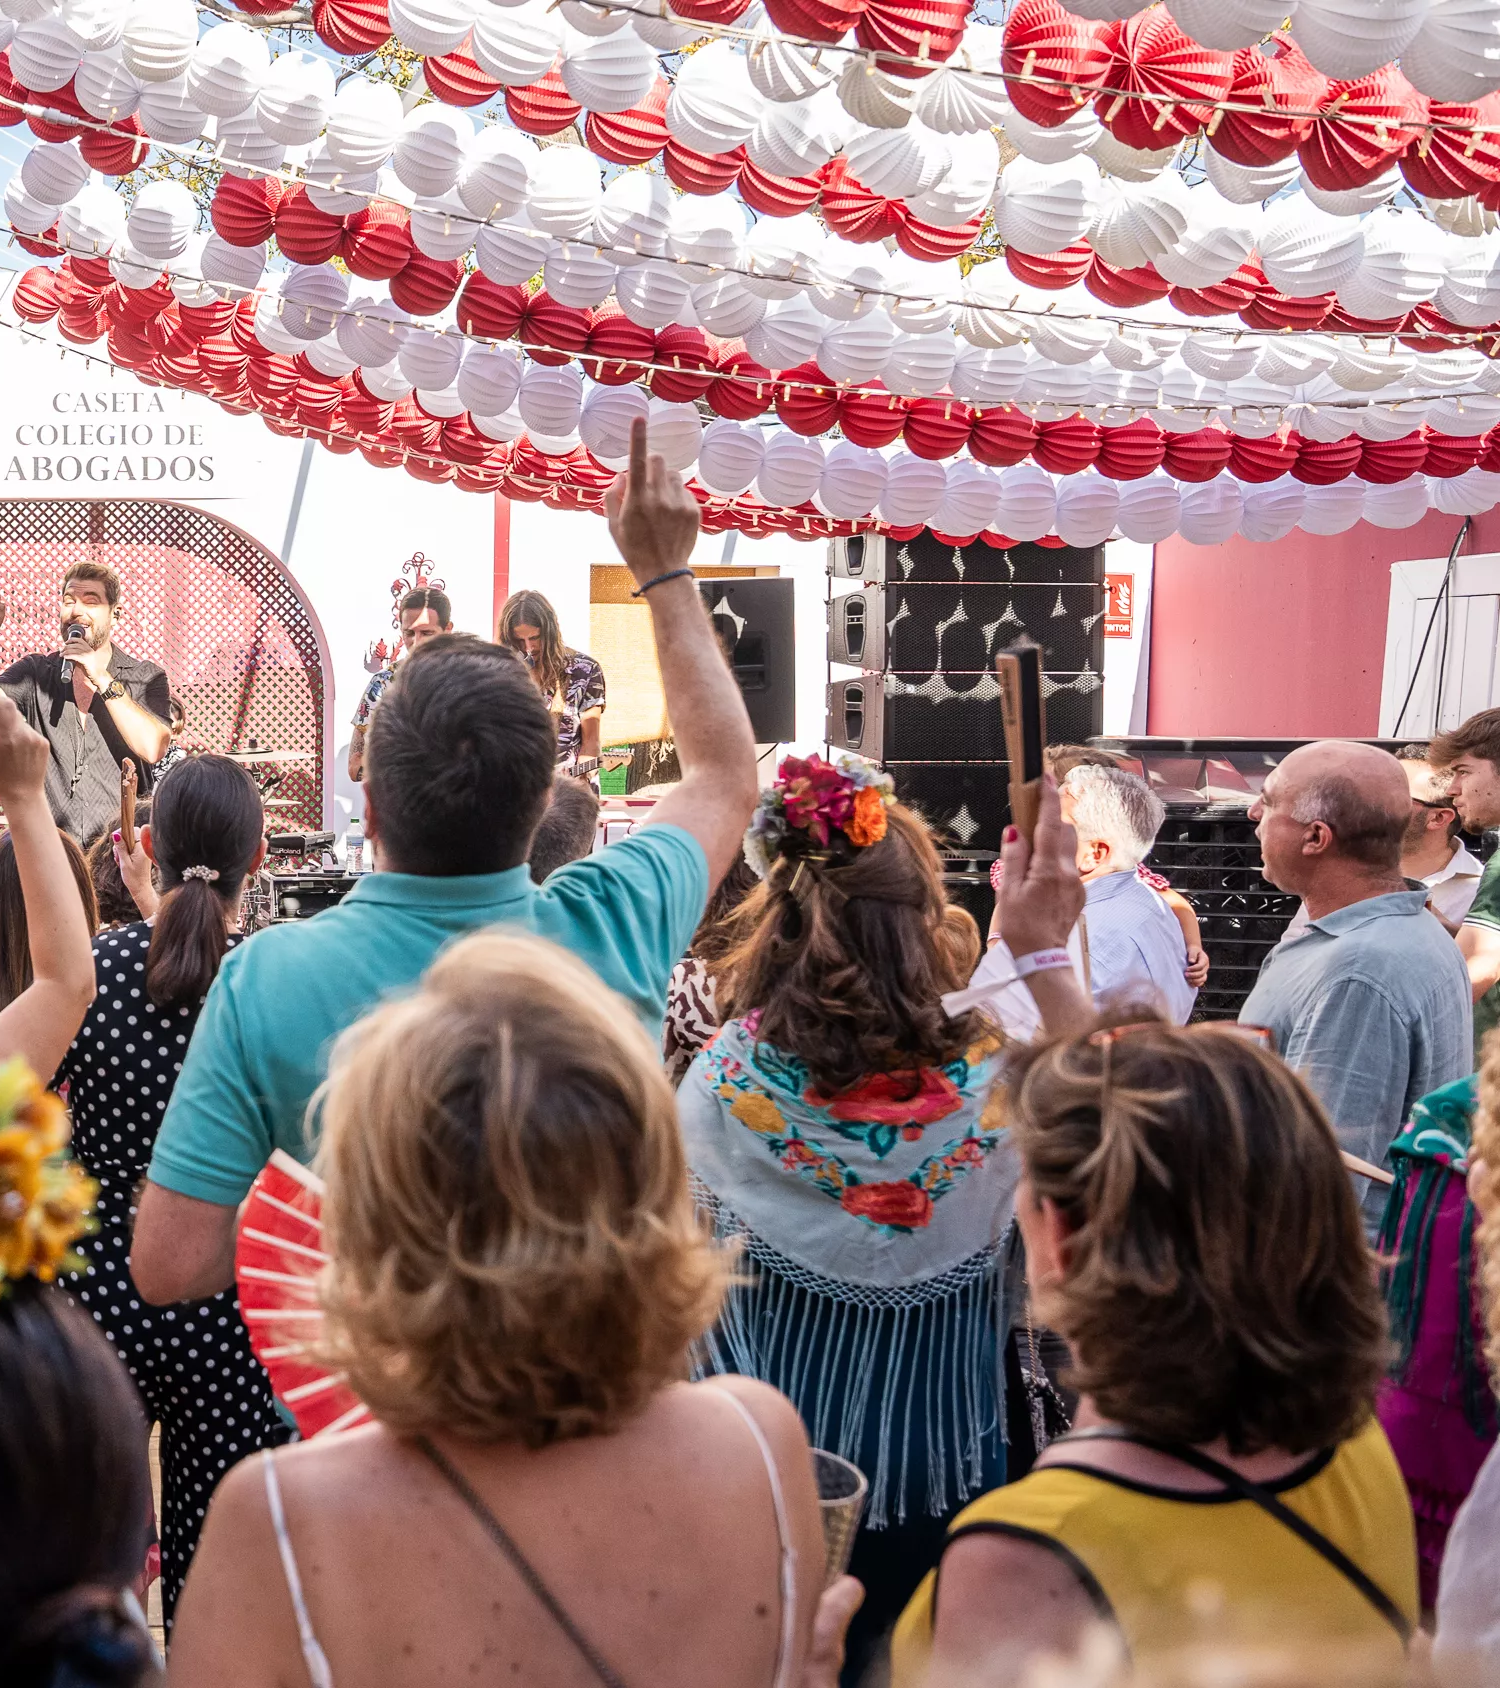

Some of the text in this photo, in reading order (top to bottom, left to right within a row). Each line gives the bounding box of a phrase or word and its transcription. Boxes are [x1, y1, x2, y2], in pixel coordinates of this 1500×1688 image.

[52, 392, 165, 413] CASETA
[15, 424, 204, 446] COLEGIO DE
[3, 455, 215, 482] ABOGADOS
[278, 847, 302, 855] Roland
